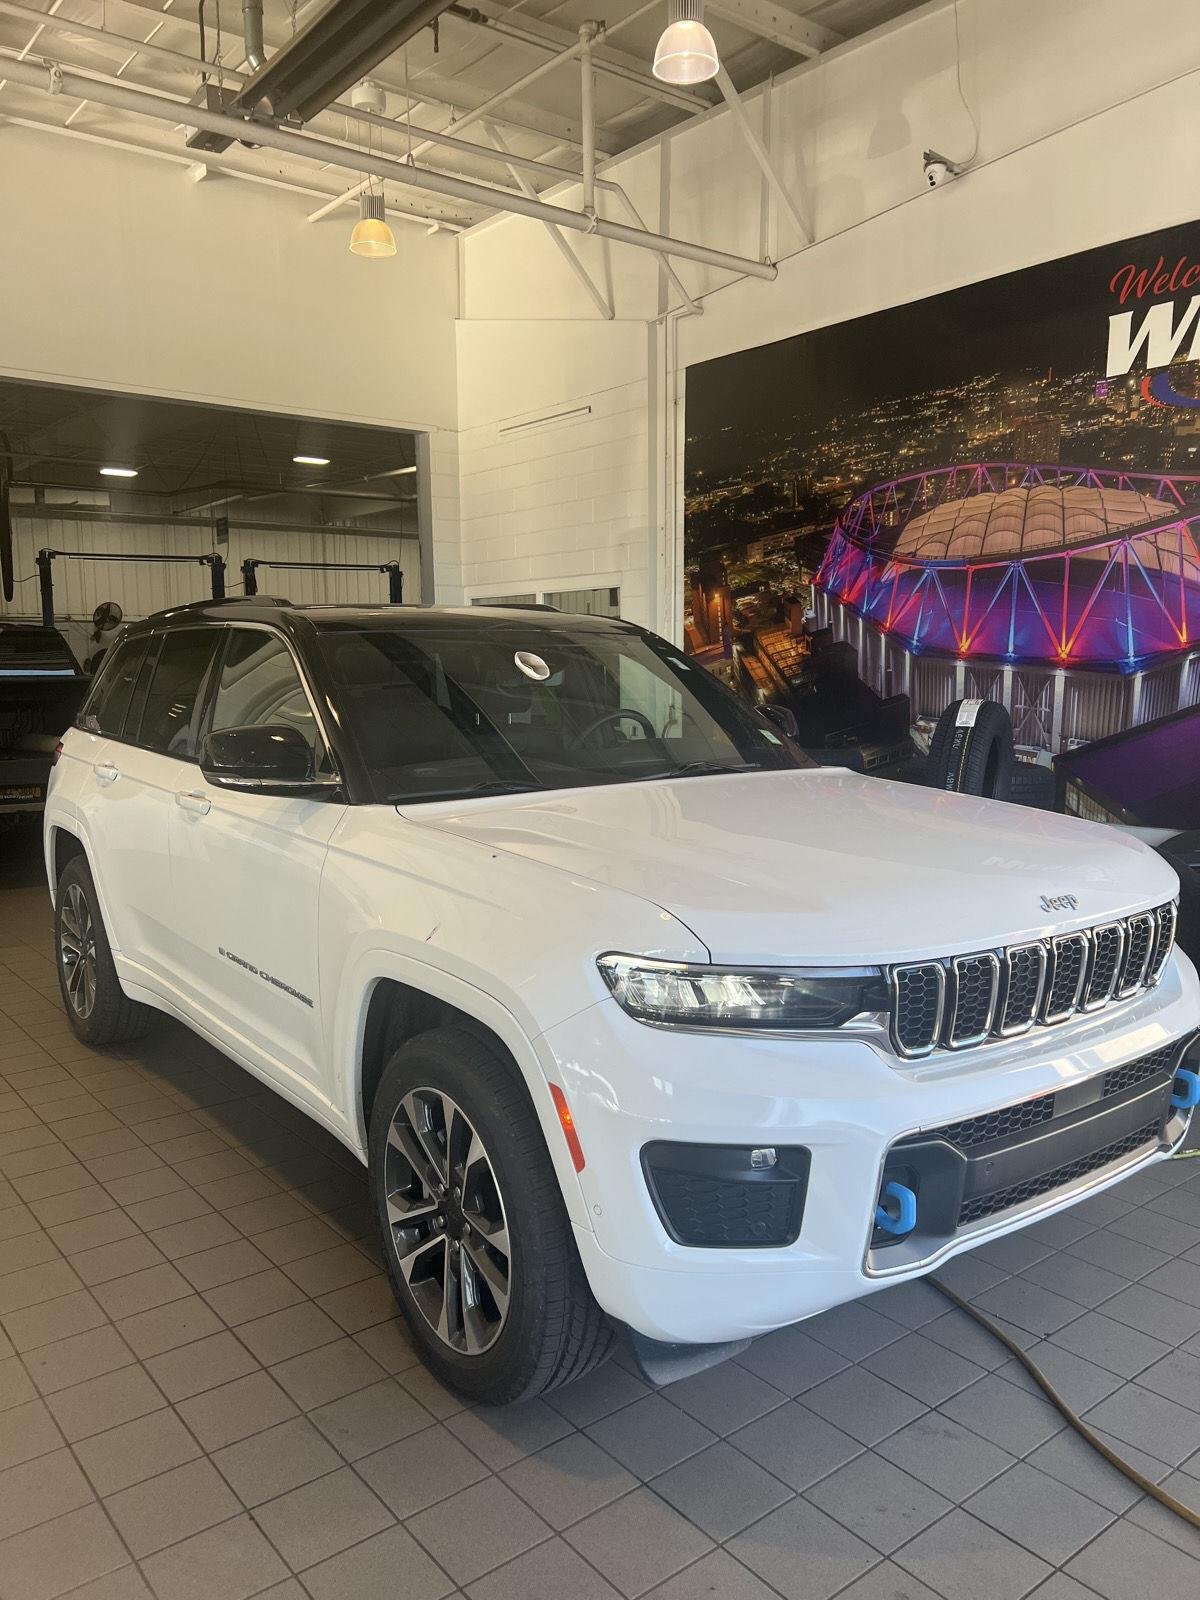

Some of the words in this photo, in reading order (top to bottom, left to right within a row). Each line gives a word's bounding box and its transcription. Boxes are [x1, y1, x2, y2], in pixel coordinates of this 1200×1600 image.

[1106, 294, 1200, 377] W
[1040, 894, 1078, 912] Jeep
[259, 971, 314, 1009] CHEROKEE
